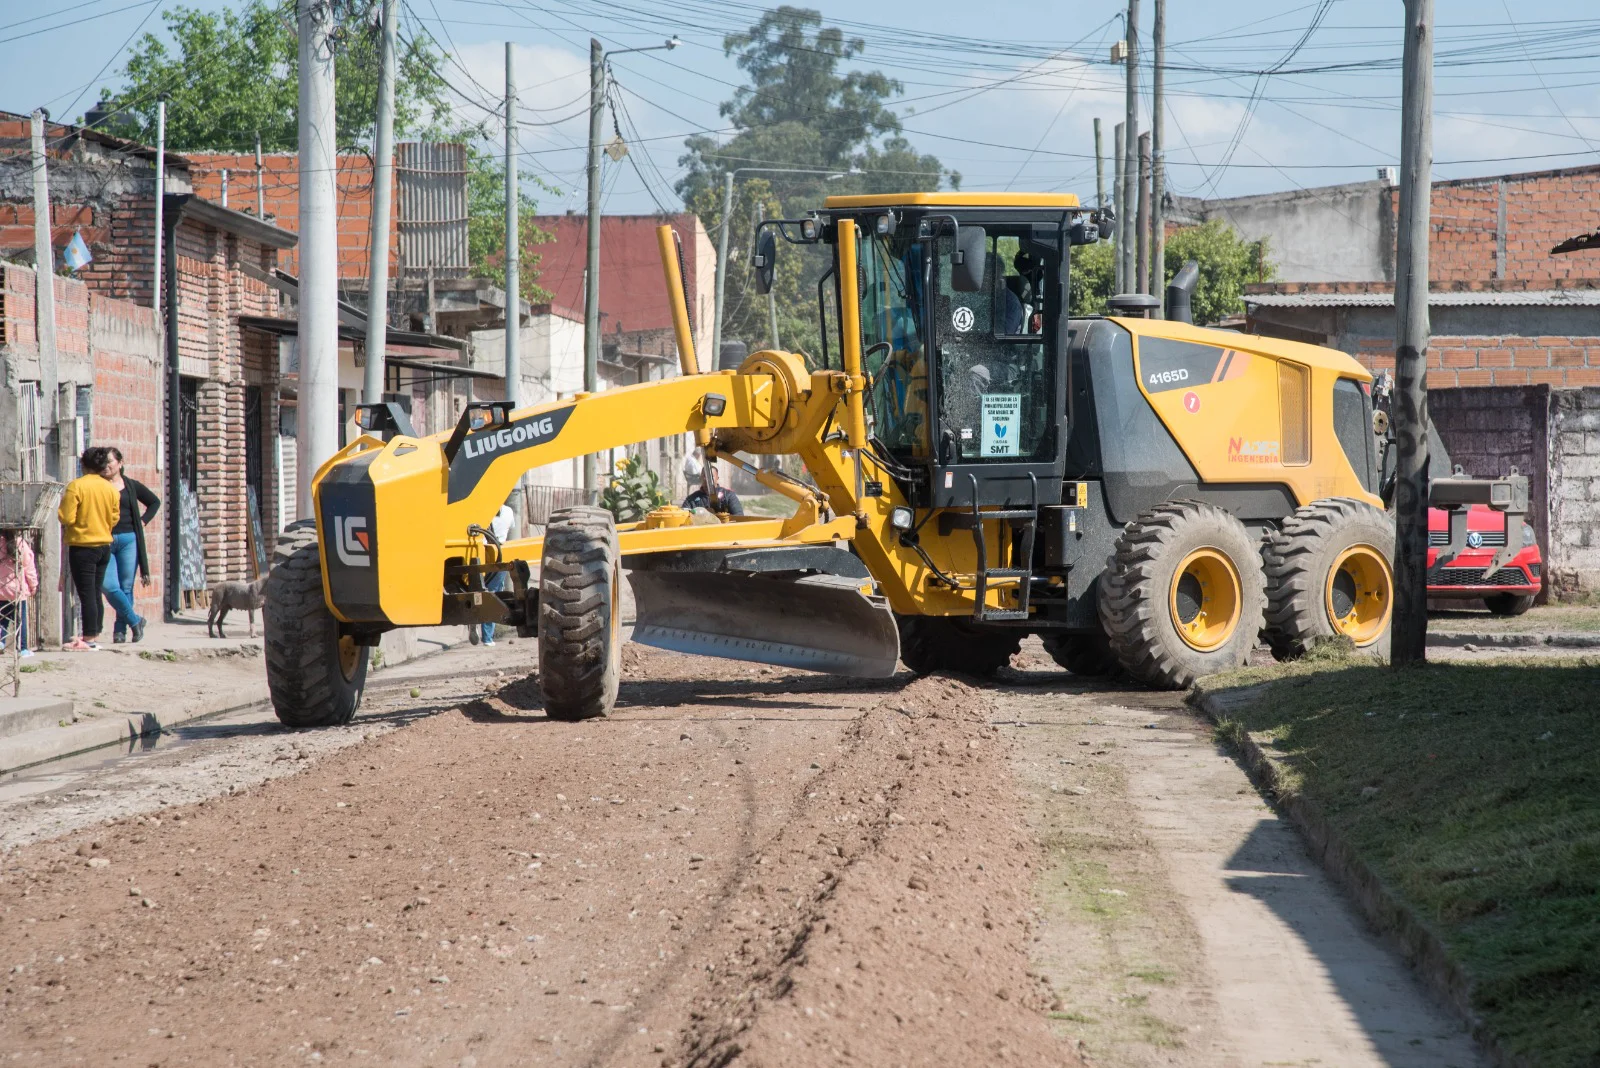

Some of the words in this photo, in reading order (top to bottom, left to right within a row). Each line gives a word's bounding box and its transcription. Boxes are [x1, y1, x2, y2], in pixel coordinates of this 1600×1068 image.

[958, 312, 967, 326] 4
[1149, 368, 1189, 385] 4165D
[463, 417, 553, 459] LIUGONG
[990, 445, 1010, 454] SMT
